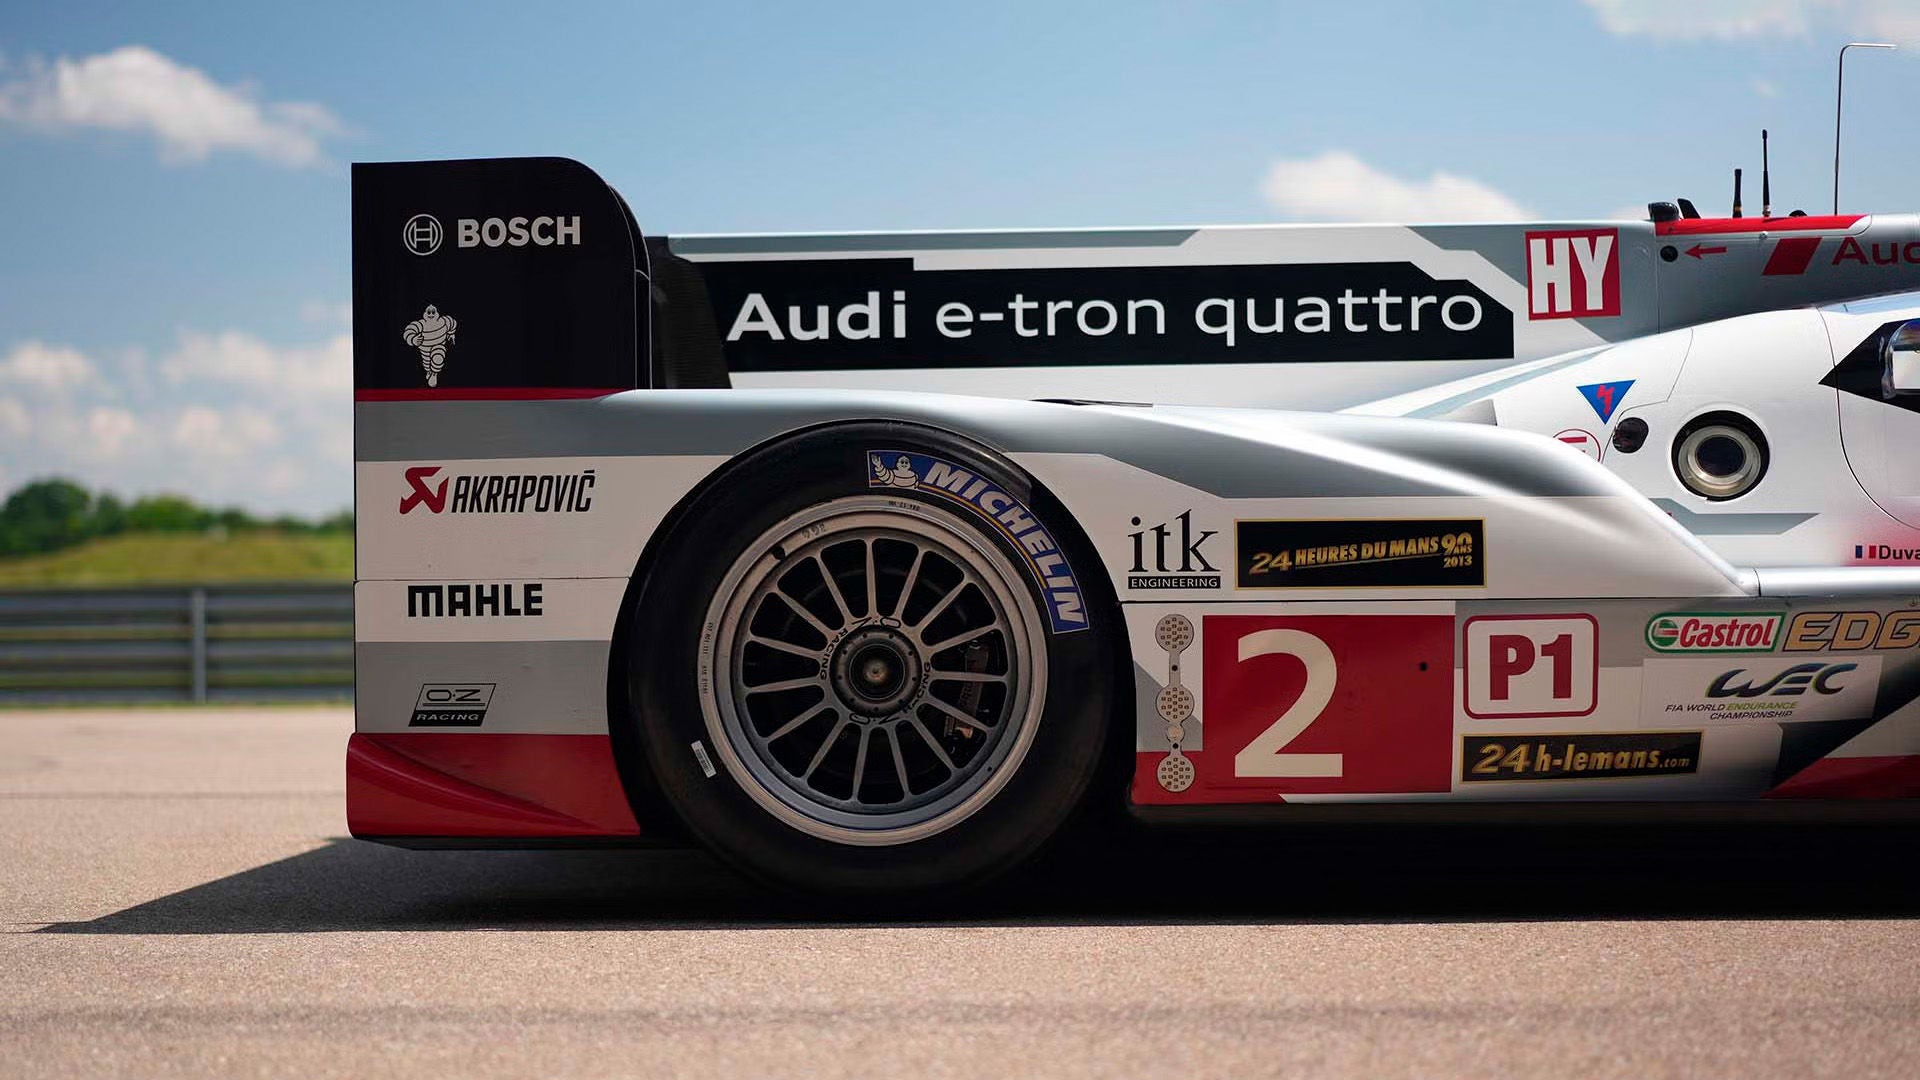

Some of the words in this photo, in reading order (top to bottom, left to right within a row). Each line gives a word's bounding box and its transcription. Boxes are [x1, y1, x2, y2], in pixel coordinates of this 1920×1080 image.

[457, 216, 581, 249] BOSCH
[1529, 235, 1614, 315] HY
[726, 290, 906, 341] Audi
[935, 293, 1166, 338] e-tron
[1195, 288, 1483, 347] quattro
[923, 461, 1085, 623] MICHELIN
[1127, 508, 1221, 572] itk
[1249, 551, 1292, 575] 24
[1295, 544, 1356, 566] HEURES
[1361, 541, 1387, 560] DU
[1389, 536, 1439, 557] MANS
[1443, 554, 1473, 569] 2013
[408, 583, 543, 618] MAHLE
[1130, 578, 1218, 588] ENGINEERING
[1680, 618, 1775, 648] Castrol
[1488, 633, 1573, 701] P1
[1705, 662, 1859, 698] WEC
[416, 713, 480, 721] RACING
[1234, 628, 1344, 778] 2
[1665, 704, 1684, 713] FIA
[1686, 703, 1727, 712] WORLD
[1726, 701, 1798, 711] ENDURANCE
[1710, 710, 1793, 720] CHAMPIONSHIP
